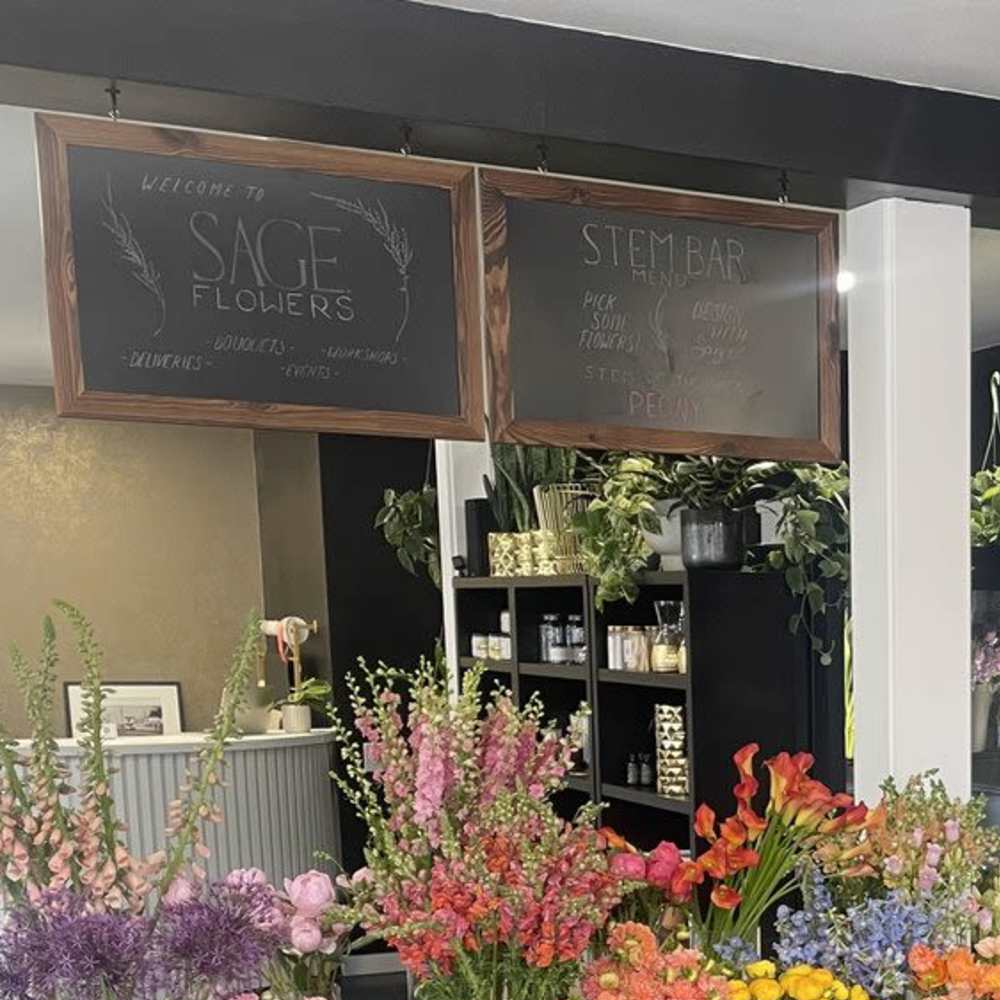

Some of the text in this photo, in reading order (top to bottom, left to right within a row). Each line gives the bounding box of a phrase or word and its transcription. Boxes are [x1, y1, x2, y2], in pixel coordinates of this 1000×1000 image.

[141, 175, 265, 201] WELCOME TO
[190, 210, 351, 293] SAGE
[582, 223, 746, 282] STEM BAR
[192, 284, 354, 322] FLOWERS
[583, 289, 617, 311] PICK
